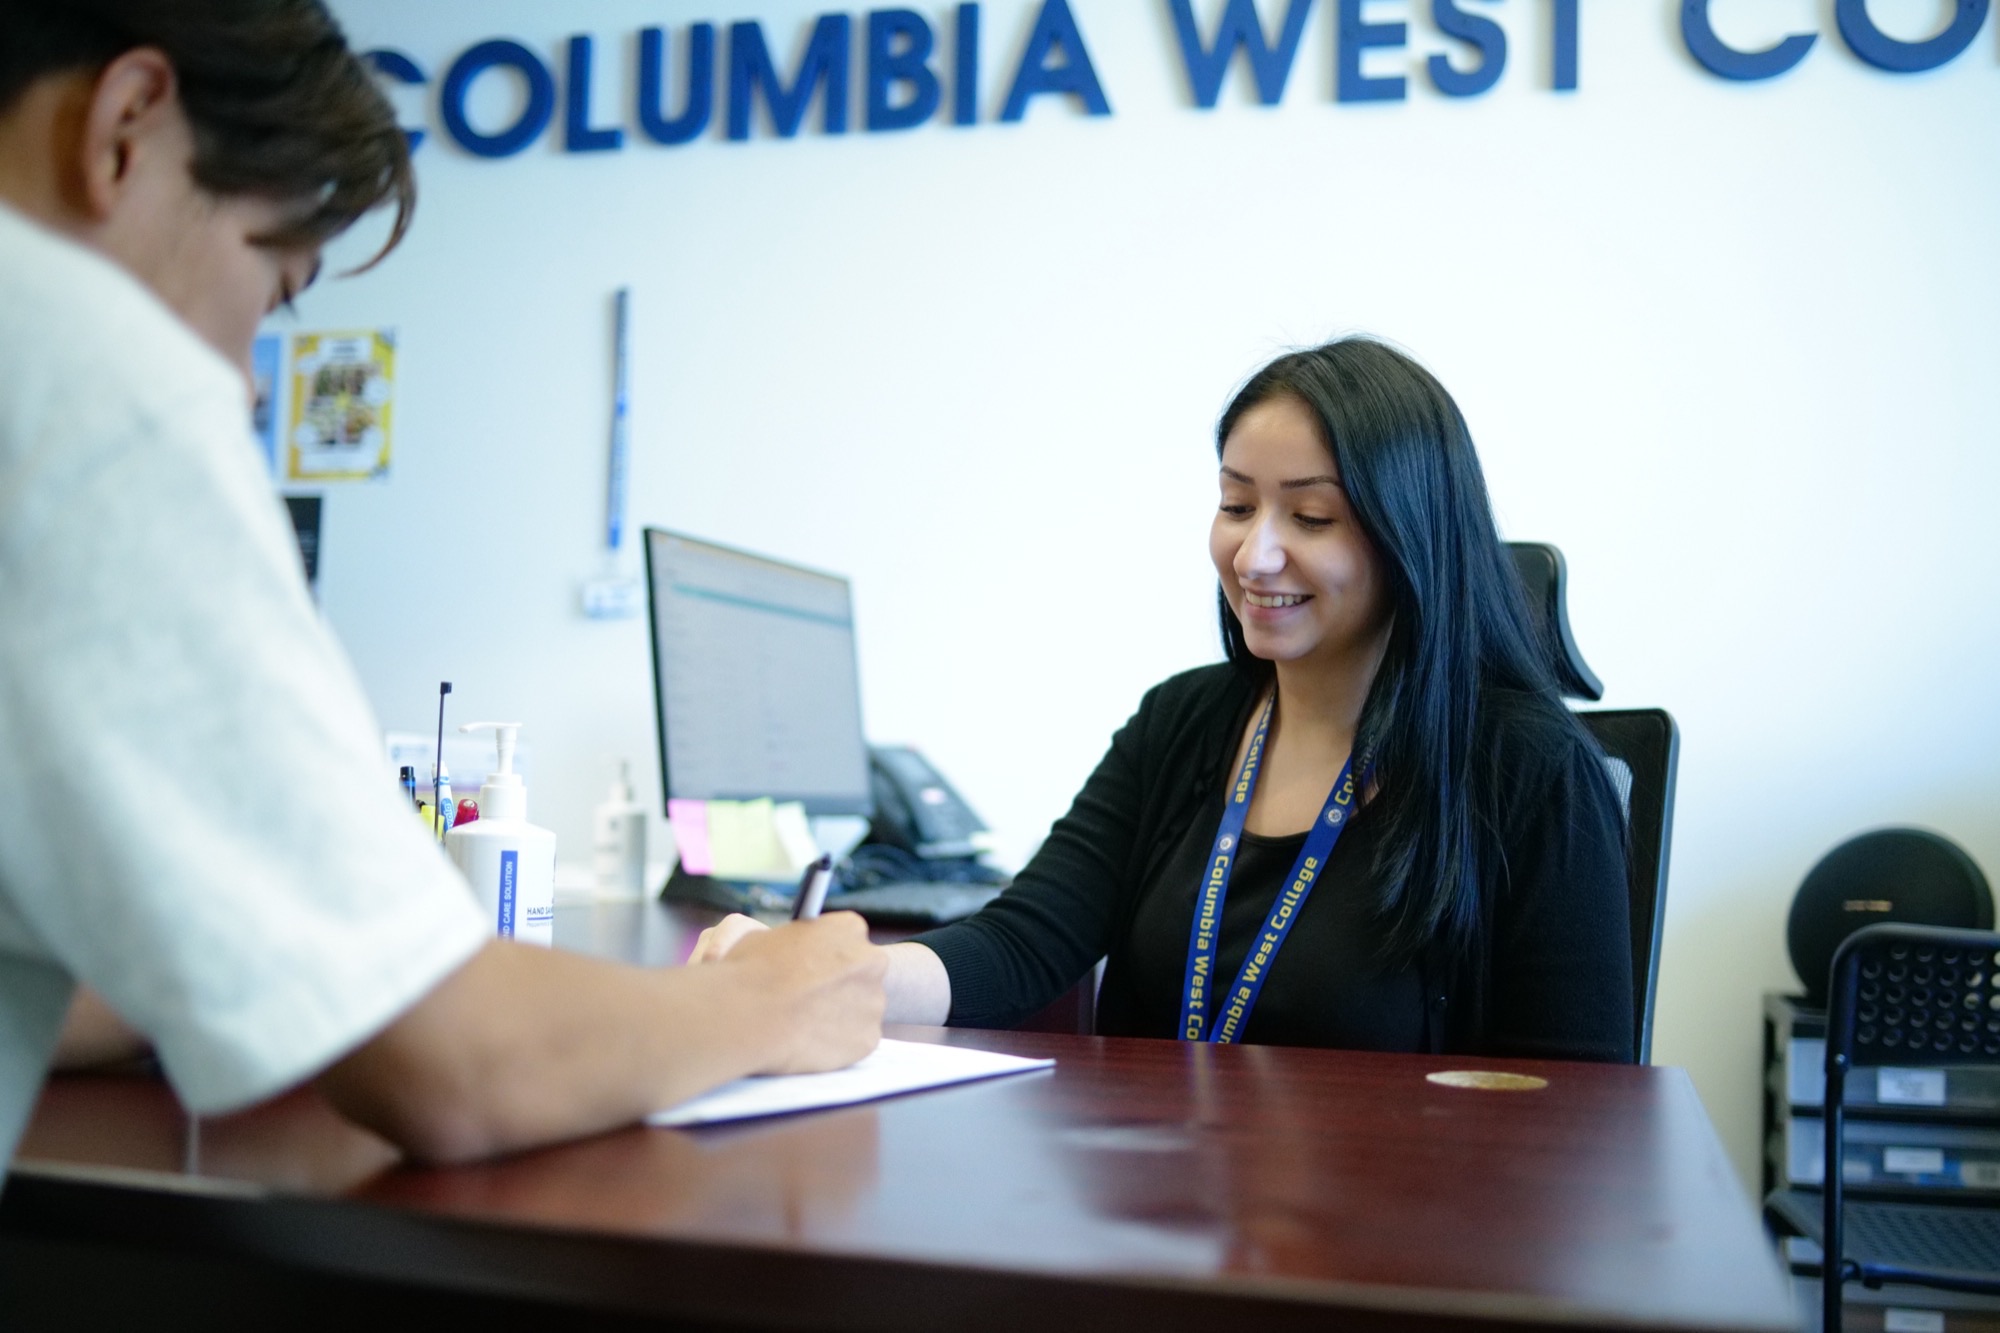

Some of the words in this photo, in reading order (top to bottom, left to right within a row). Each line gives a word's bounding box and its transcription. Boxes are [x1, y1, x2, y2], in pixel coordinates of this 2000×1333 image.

[1235, 735, 1263, 803] College
[504, 861, 513, 900] SOLUTION
[1197, 855, 1229, 950] Columbia
[503, 902, 511, 924] CARE
[527, 907, 544, 915] HAND
[1242, 932, 1278, 983] West
[1271, 856, 1318, 930] College
[1189, 956, 1209, 1009] West
